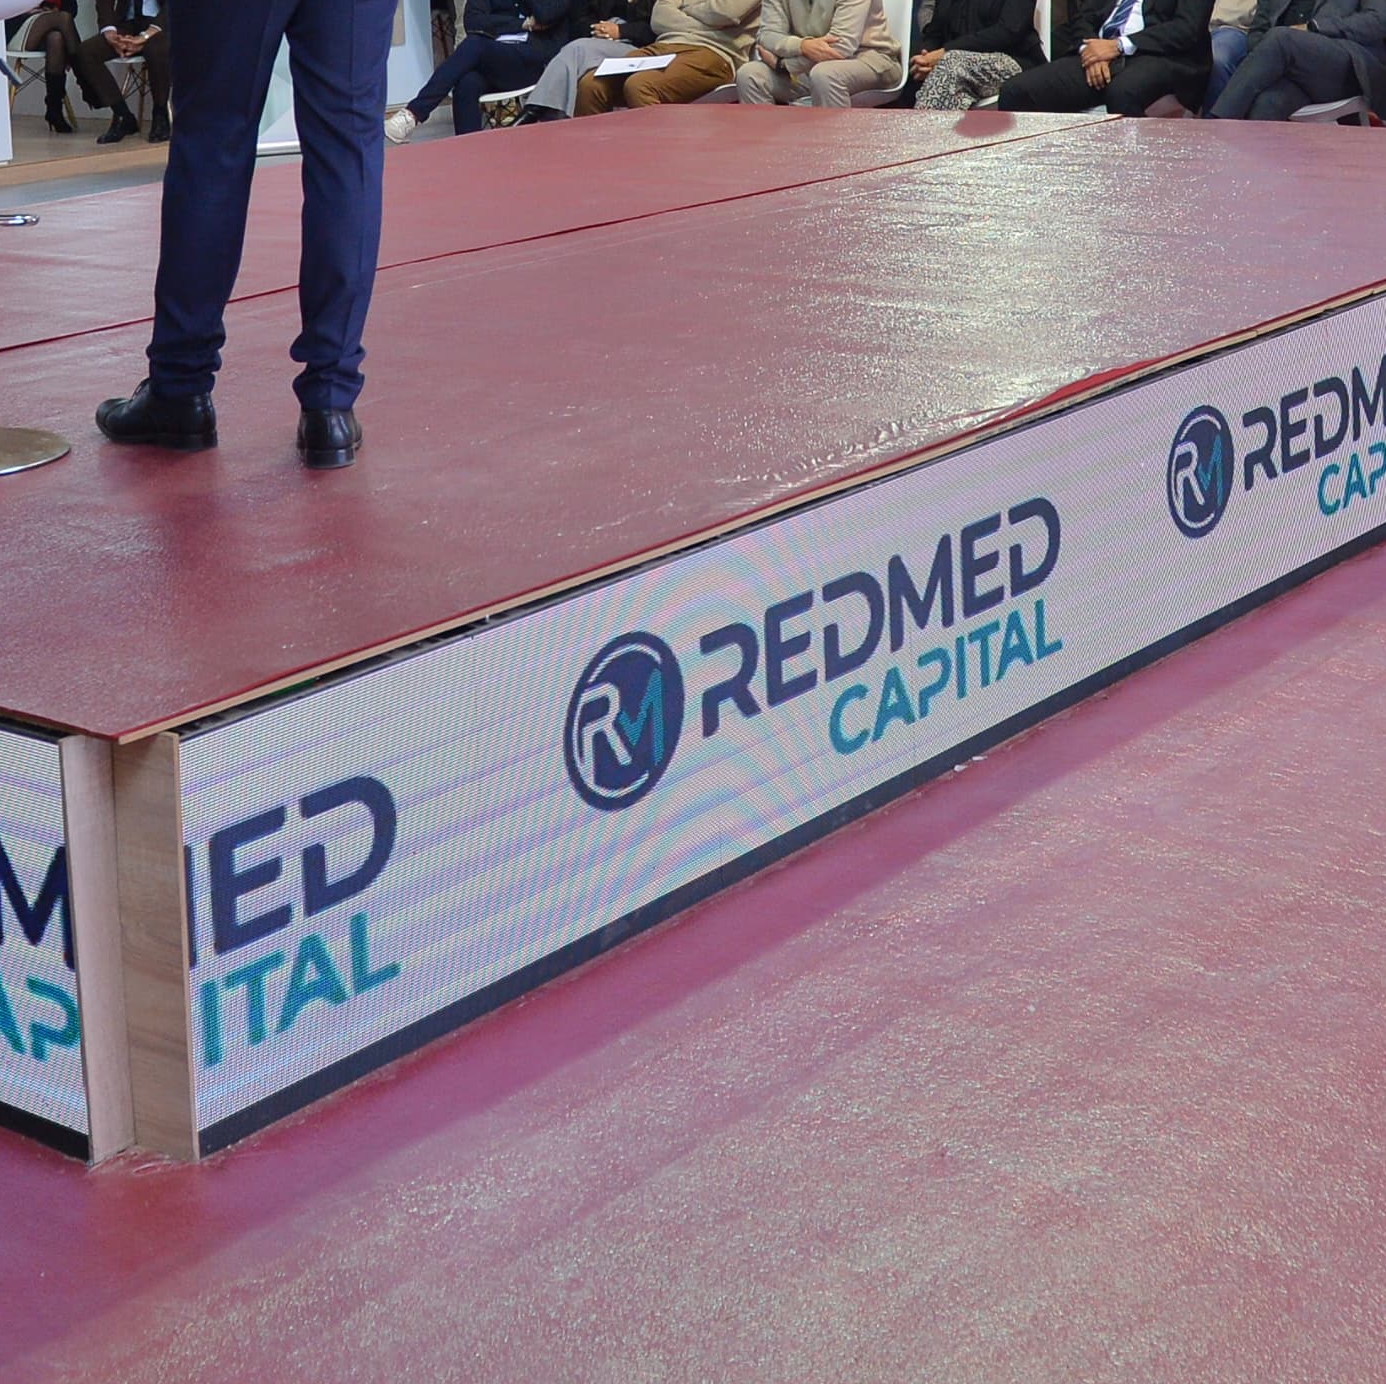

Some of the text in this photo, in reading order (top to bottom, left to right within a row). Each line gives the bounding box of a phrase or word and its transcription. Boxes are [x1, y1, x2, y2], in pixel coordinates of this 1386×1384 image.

[699, 496, 1062, 738] REDMED
[830, 600, 1065, 756] CAPITAL
[184, 774, 398, 968] ED
[199, 912, 401, 1068] ITAL
